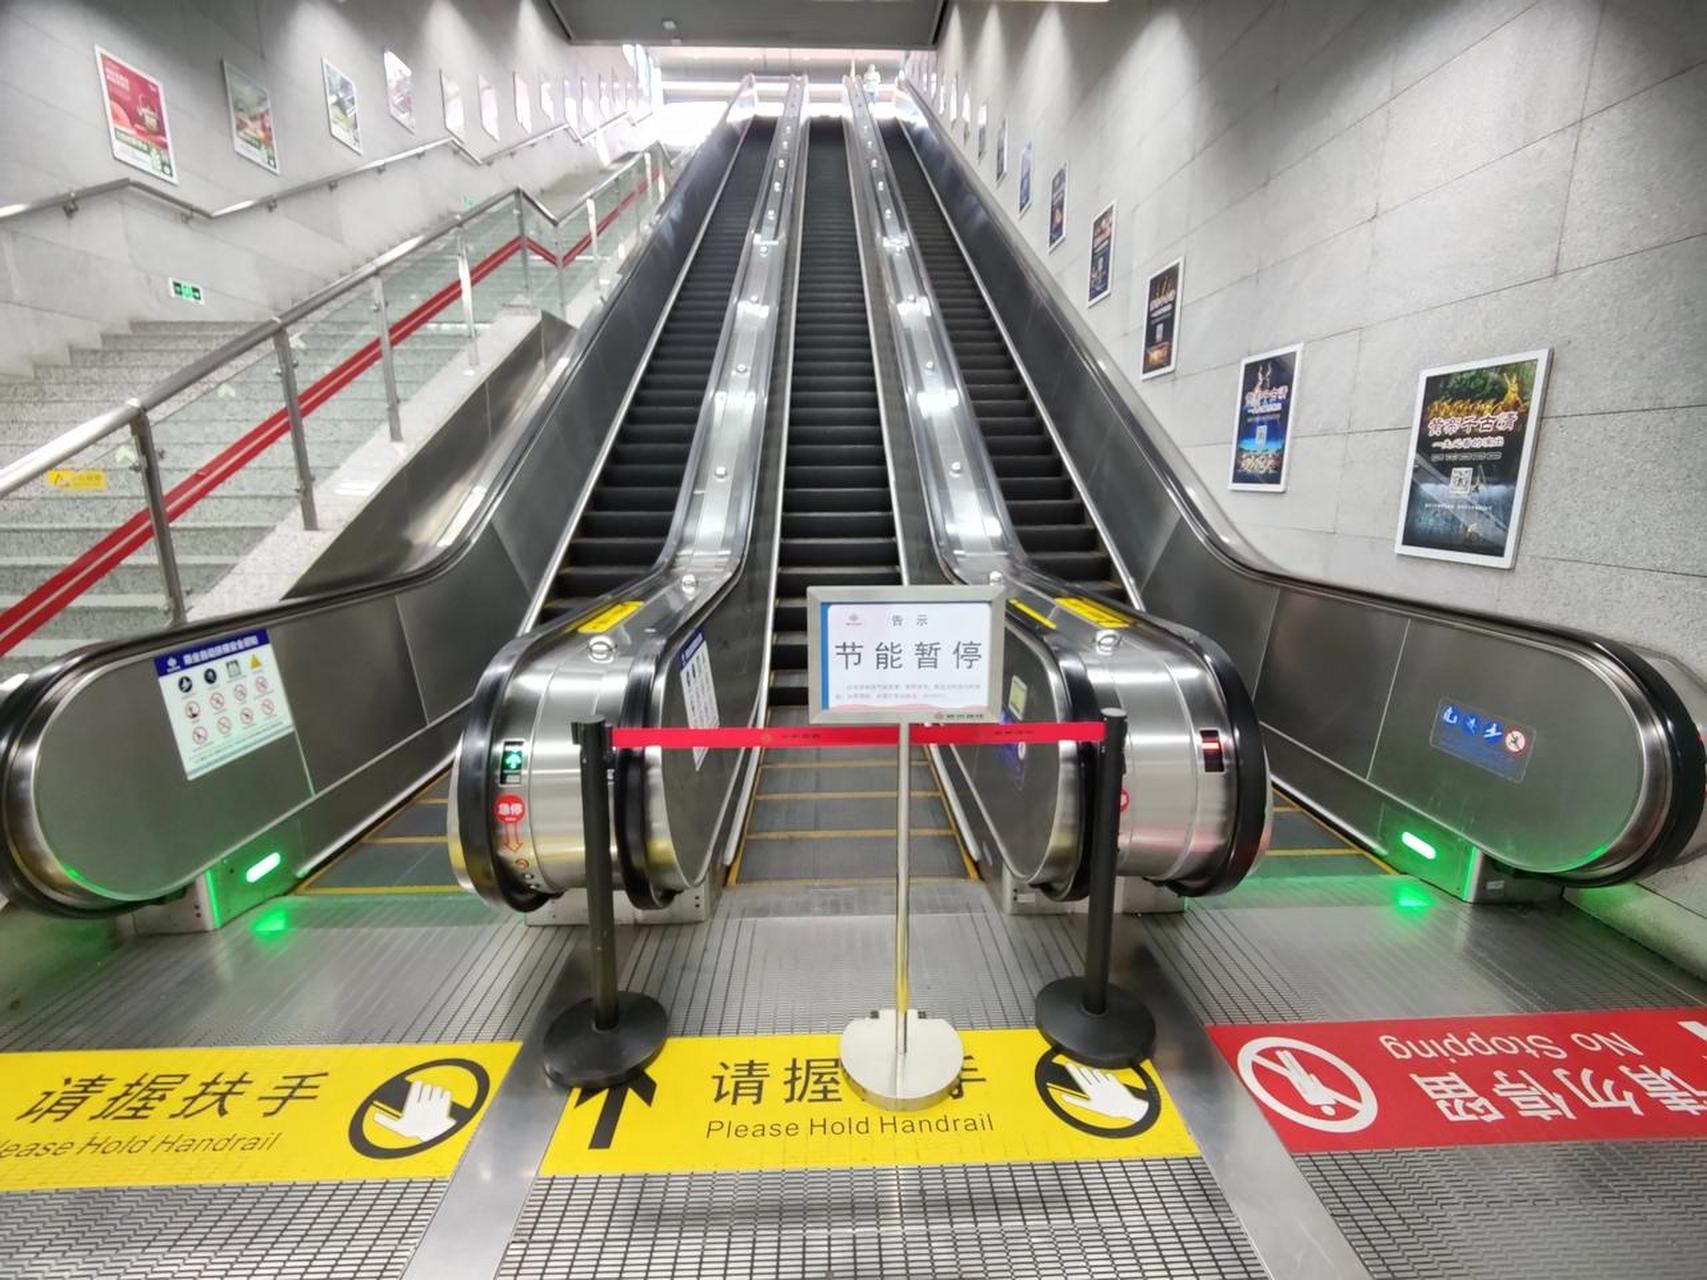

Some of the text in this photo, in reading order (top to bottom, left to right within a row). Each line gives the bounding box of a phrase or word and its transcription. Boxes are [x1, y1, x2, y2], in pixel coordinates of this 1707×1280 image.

[892, 614, 928, 627] 告示
[835, 641, 982, 670] 节能暂停
[1379, 1032, 1644, 1064] No Stopping
[16, 1072, 329, 1124] 请握扶手
[1409, 1065, 1707, 1122] 请勿停留
[706, 1112, 994, 1139] Please Hold Handrail
[76, 1135, 156, 1155] Hold
[150, 1131, 282, 1153] Handrail
